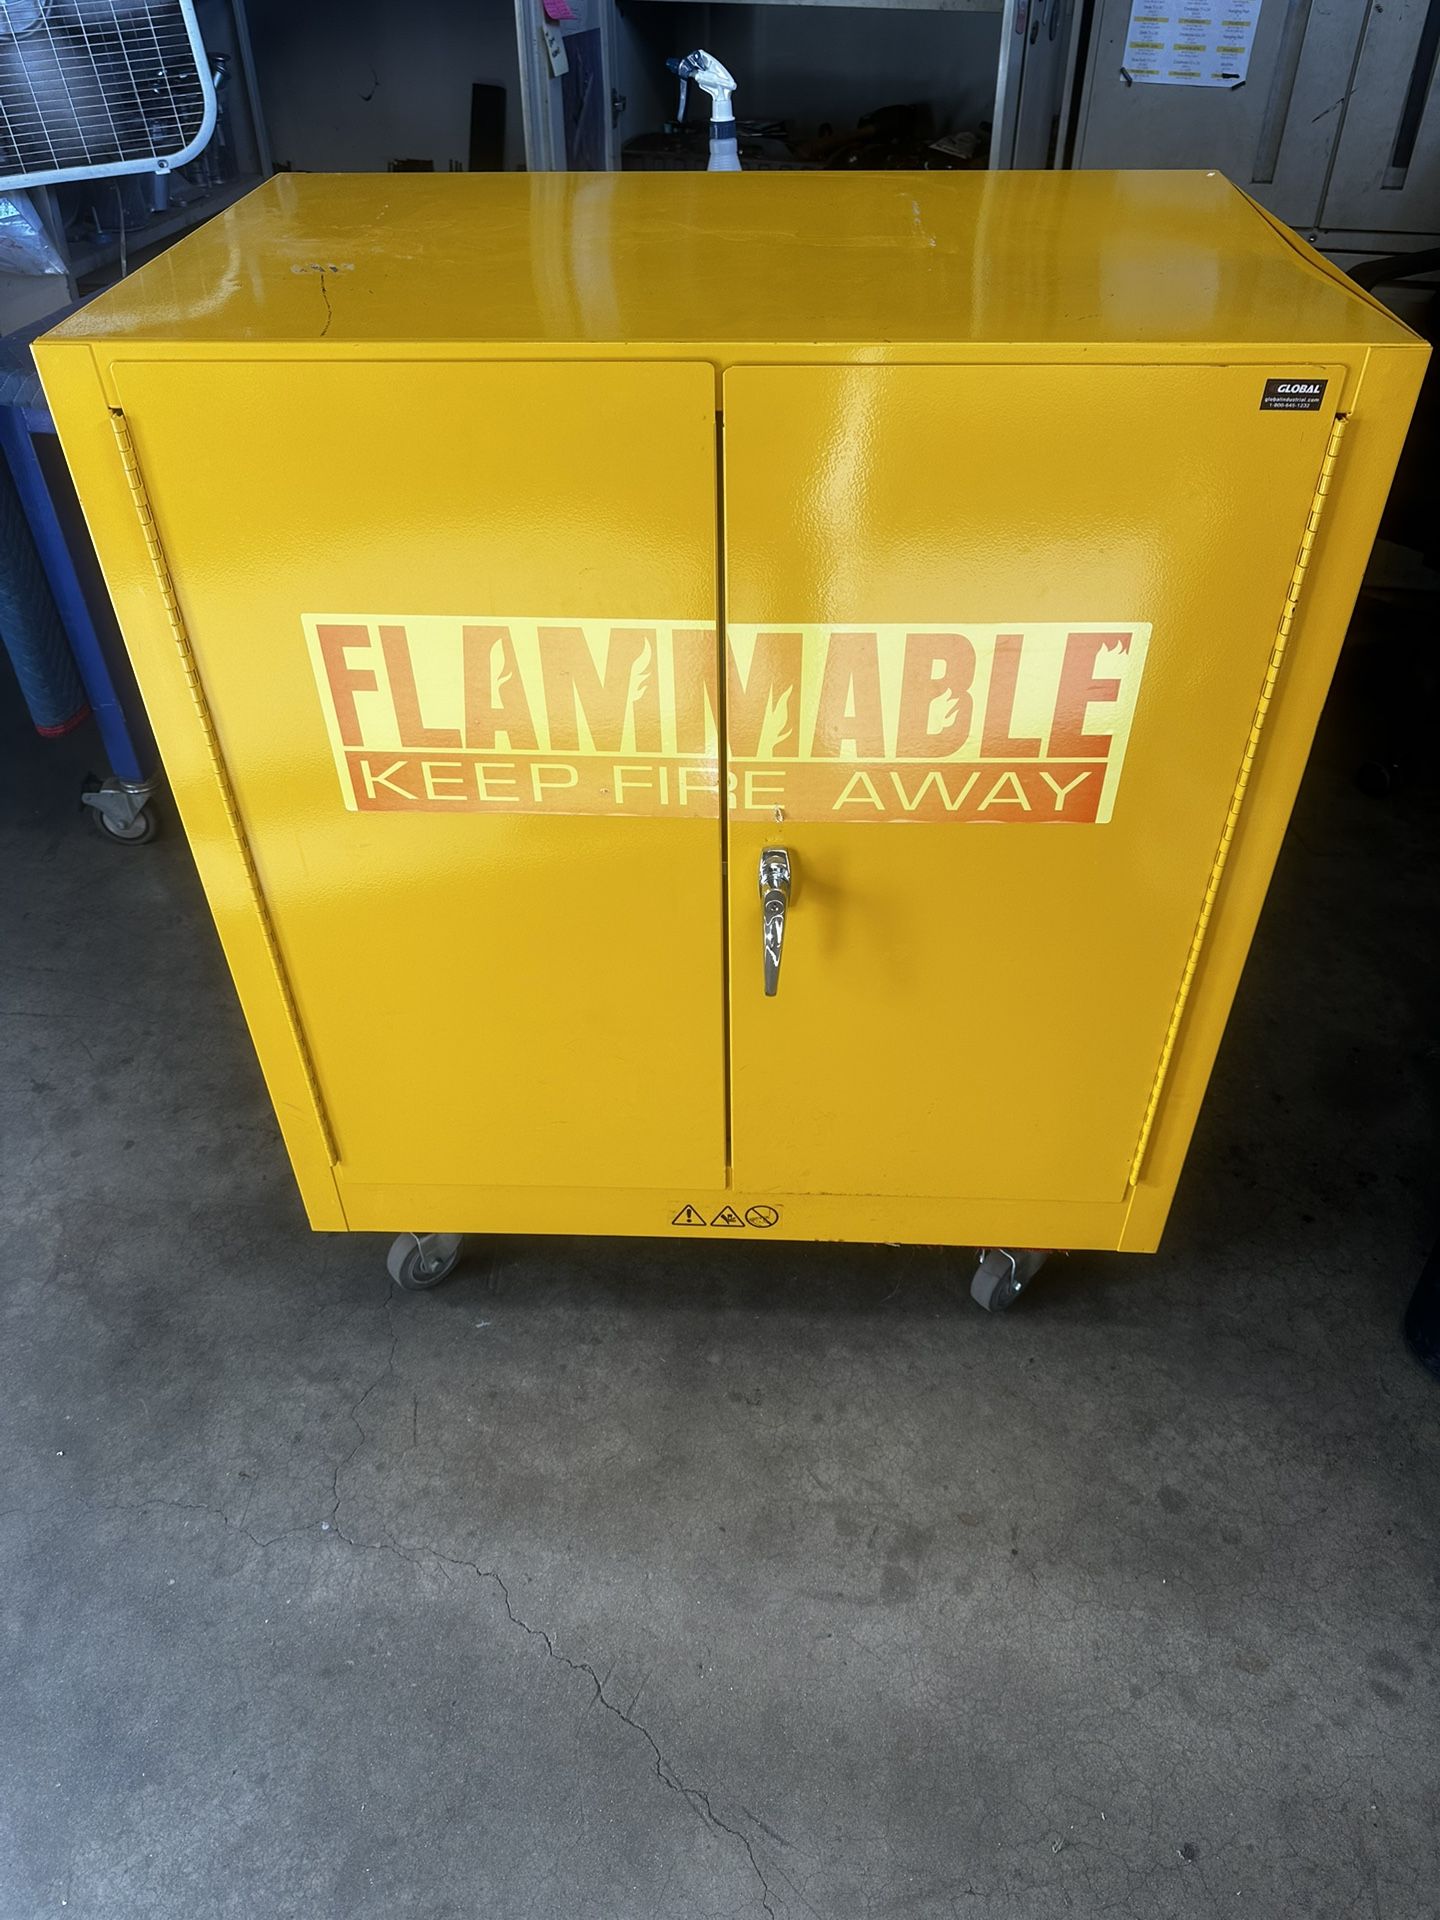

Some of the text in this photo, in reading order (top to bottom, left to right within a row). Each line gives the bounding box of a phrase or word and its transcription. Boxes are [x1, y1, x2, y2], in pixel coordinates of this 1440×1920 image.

[1277, 384, 1320, 394] GLOBAL
[316, 623, 1132, 758] FLAMMABLE
[359, 760, 1093, 812] KEEP FIRE AWAY
